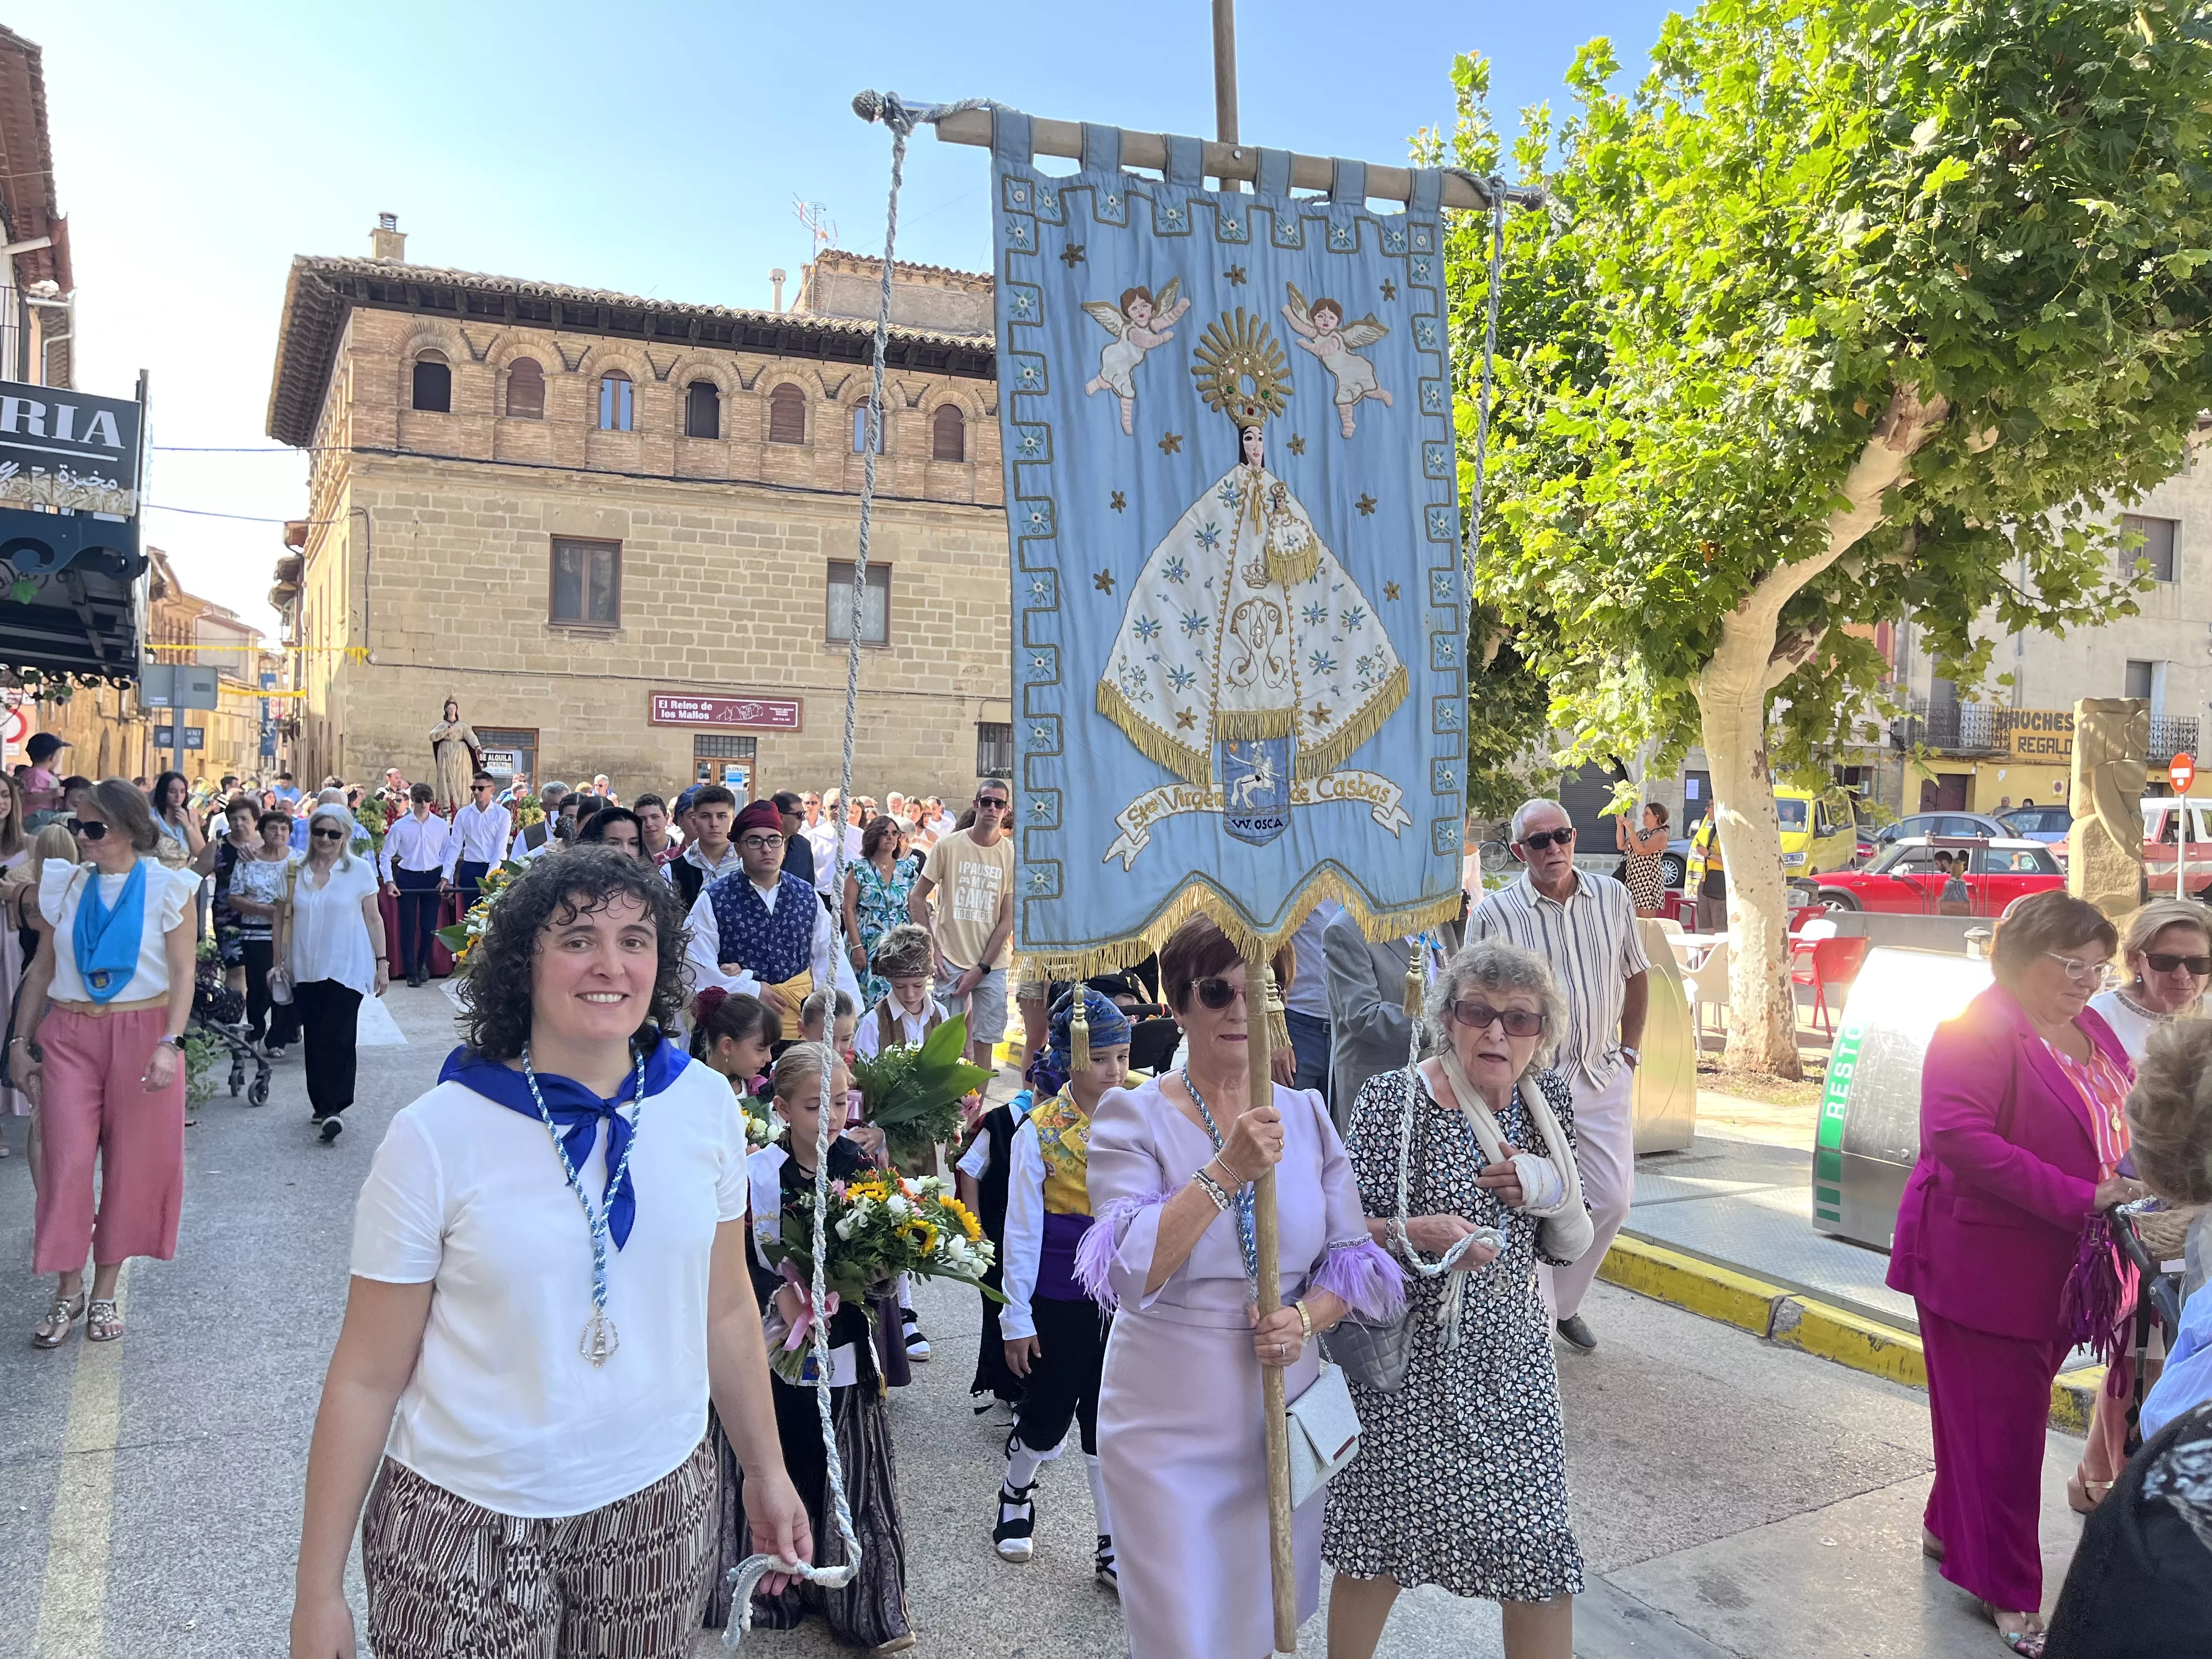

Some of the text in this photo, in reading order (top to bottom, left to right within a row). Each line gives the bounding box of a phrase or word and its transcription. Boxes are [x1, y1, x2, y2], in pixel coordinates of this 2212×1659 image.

[0, 396, 126, 449] RIA
[58, 464, 118, 493] مخبزة
[658, 699, 713, 710] El Reino de
[661, 709, 710, 720] los Mallos
[479, 753, 512, 762] SE ALQUILA
[1158, 787, 1225, 811] Virgen
[1290, 781, 1310, 802] de
[1317, 773, 1390, 803] Casbas
[1255, 818, 1283, 830] OSCA
[958, 861, 1003, 879] I PAUSED
[971, 876, 986, 889] MY
[955, 886, 997, 912] GAME
[955, 909, 964, 918] TO
[966, 910, 975, 920] BE
